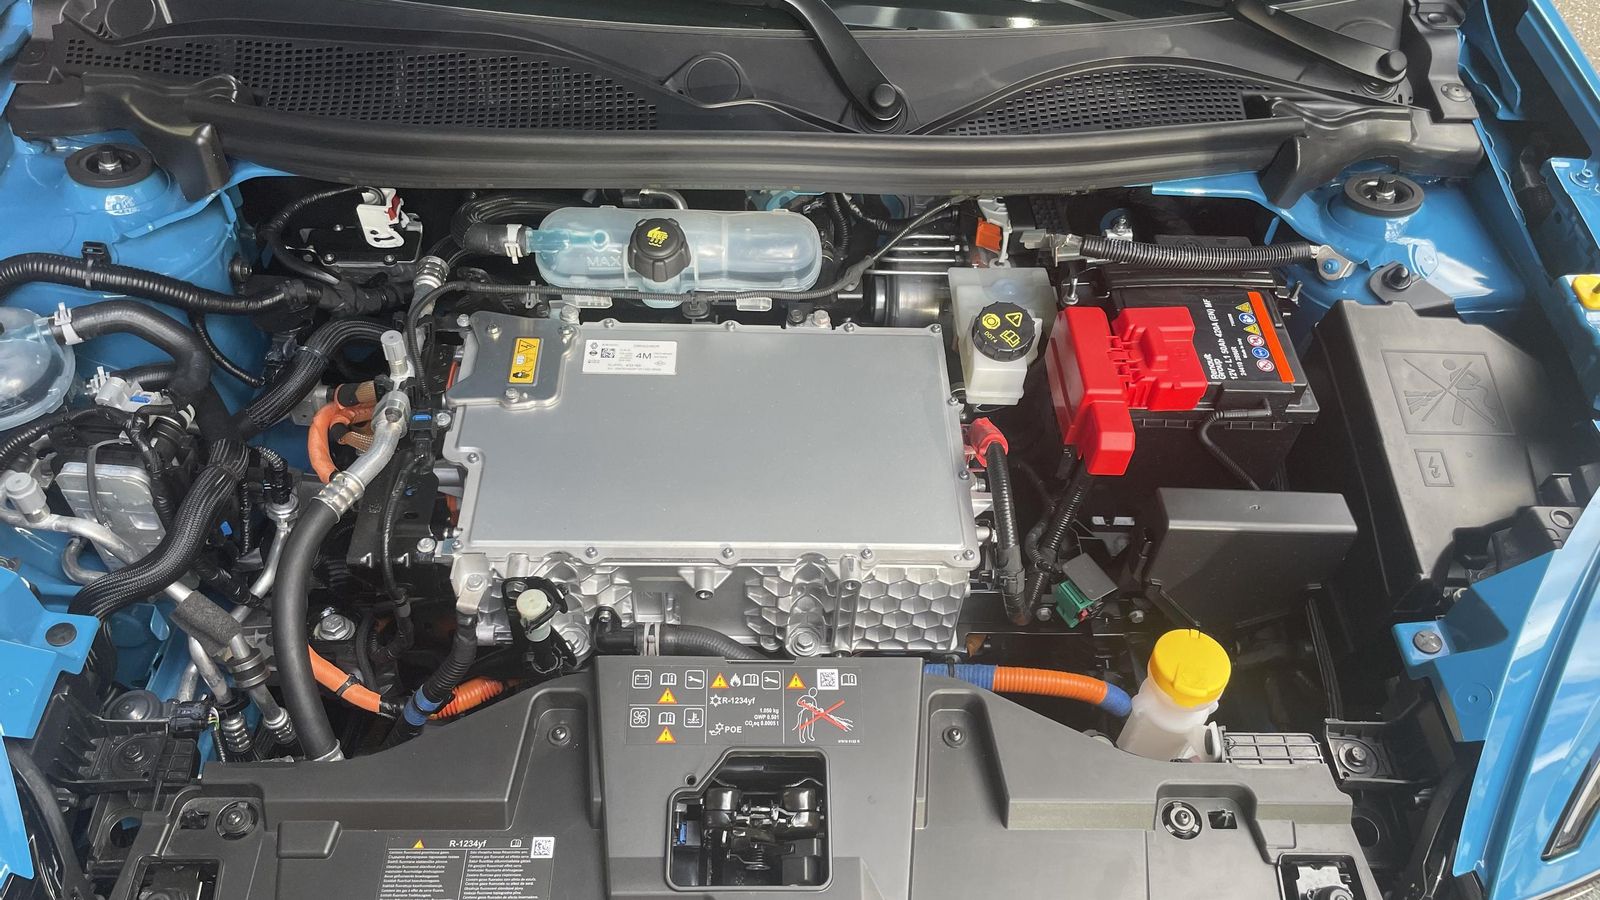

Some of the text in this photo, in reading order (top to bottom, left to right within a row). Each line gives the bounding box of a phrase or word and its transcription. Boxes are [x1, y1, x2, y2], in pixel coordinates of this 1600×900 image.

[586, 256, 621, 267] MAX
[984, 330, 995, 341] DOT
[635, 352, 652, 360] 4M
[1203, 353, 1220, 379] Renault
[1213, 358, 1227, 380] Group
[1227, 367, 1238, 380] 12V
[722, 697, 756, 706] R-1234yf
[724, 726, 743, 734] POE
[448, 840, 488, 849] R-1234yf
